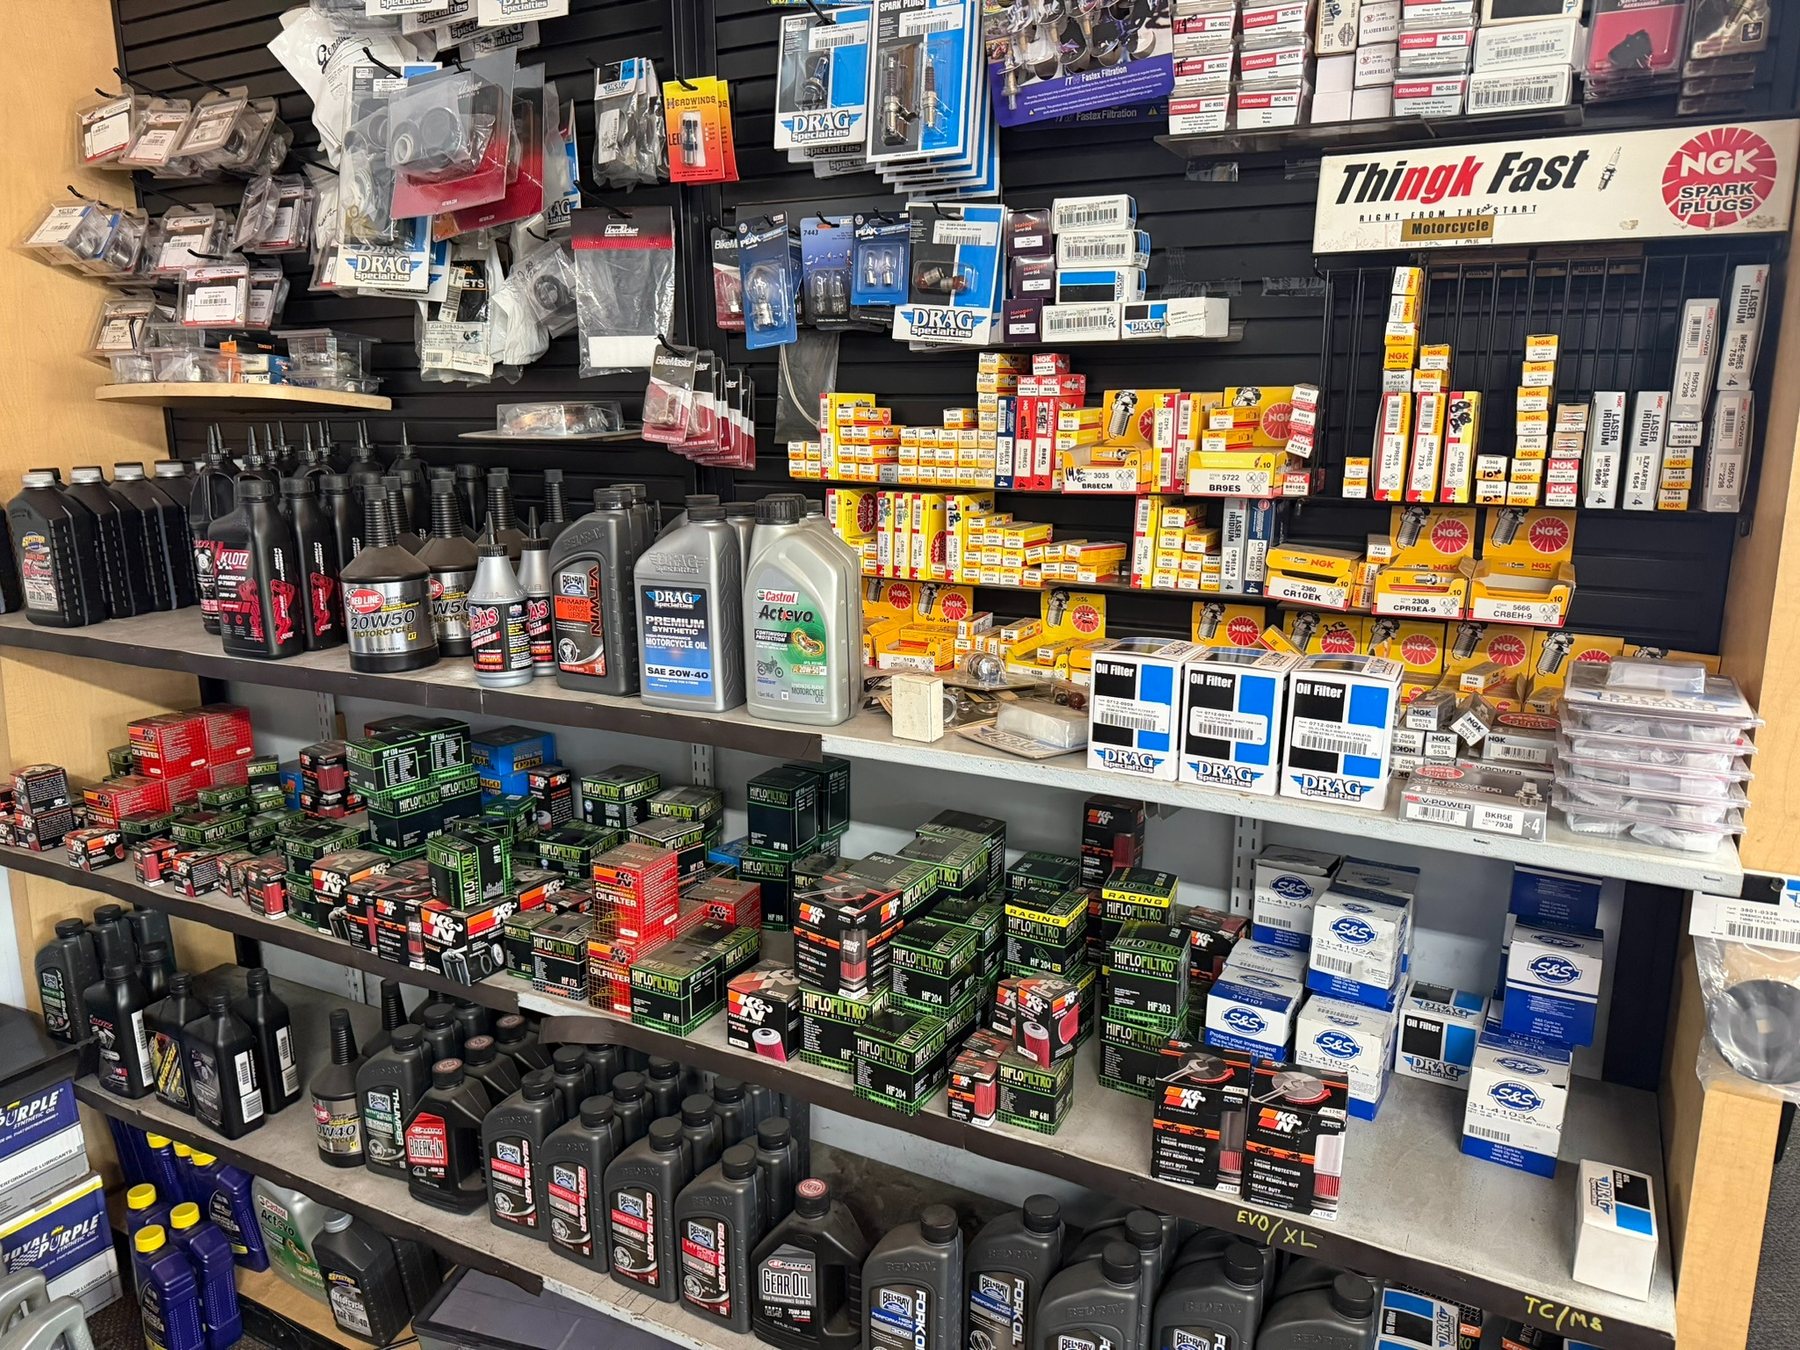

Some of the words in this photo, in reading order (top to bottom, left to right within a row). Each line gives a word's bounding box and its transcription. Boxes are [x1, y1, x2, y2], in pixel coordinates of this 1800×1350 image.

[880, 0, 900, 12] SPARK
[902, 0, 925, 10] PLUGS
[1246, 14, 1275, 24] STANDARD
[1082, 71, 1101, 82] Fastex
[1102, 65, 1127, 79] Filtration
[1102, 108, 1137, 119] Filtration
[1171, 103, 1198, 111] STANDARD
[792, 111, 850, 131] DRAG
[791, 128, 850, 140] Specialties
[1680, 149, 1760, 177] NGK
[1335, 155, 1484, 205] Thingk
[1486, 149, 1590, 195] Fast
[1680, 182, 1756, 199] SPARK
[1493, 203, 1537, 215] START
[1679, 198, 1753, 215] PLUGS
[855, 226, 878, 238] PEAK
[1411, 219, 1489, 235] Motorcycle
[356, 254, 411, 274] DRAG
[1736, 285, 1751, 323] IRIDIUM
[1746, 289, 1760, 319] LASER
[912, 308, 974, 329] DRAG
[1130, 320, 1164, 331] DRAG
[910, 326, 974, 338] Specialties
[655, 354, 695, 368] BikeMaster
[1387, 352, 1409, 360] NGK
[1601, 409, 1612, 445] IRIDIUM
[1610, 414, 1620, 441] LASER
[1639, 410, 1652, 446] IRIDIUM
[1650, 414, 1660, 442] LASER
[1551, 460, 1573, 469] NGK
[1093, 472, 1110, 480] 3035
[1221, 473, 1240, 481] 5722
[1081, 482, 1113, 490] BR8ECM
[1209, 484, 1242, 493] BR9ES
[1551, 485, 1573, 493] NGK
[1228, 512, 1236, 542] IRIDIUM
[1234, 515, 1242, 539] LASER
[1437, 528, 1462, 538] NGK
[1536, 526, 1562, 537] NGK
[221, 552, 249, 566] KLOTZ
[1310, 558, 1336, 569] NGK
[352, 596, 362, 606] RED
[364, 595, 381, 606] LINE
[655, 591, 693, 603] DRAG
[765, 591, 795, 603] Castrol
[1283, 589, 1322, 601] CR10EK
[759, 605, 815, 622] Actevo
[1393, 604, 1436, 613] CPR9EA-9
[1493, 610, 1532, 620] CR8EH-9
[350, 609, 416, 630] 20W50
[645, 616, 704, 629] PREMIUM
[354, 624, 413, 638] MOTORCYCLE
[652, 626, 698, 635] SYNTHETIC
[1231, 624, 1253, 633] NGK
[646, 638, 693, 648] MOTORCYCLE
[1406, 642, 1431, 651] NGK
[1494, 643, 1519, 652] NGK
[648, 667, 666, 675] SAE
[669, 669, 709, 679] 20W-40
[1096, 662, 1109, 674] Oil
[1110, 664, 1134, 678] Filter
[1190, 672, 1204, 685] Oil
[1206, 674, 1233, 688] Filter
[1296, 682, 1312, 694] Oil
[1314, 684, 1343, 698] Filter
[1104, 749, 1154, 768] DRAG
[1103, 762, 1154, 773] Specialties
[1198, 761, 1252, 781] DRAG
[1198, 774, 1252, 787] Specialties
[1302, 774, 1362, 796] DRAG
[1301, 788, 1361, 801] Specialties
[1422, 797, 1471, 810] V-POWER
[1485, 811, 1512, 821] BKR5E
[1495, 821, 1513, 829] 7938
[1278, 881, 1305, 895] S&S
[1108, 892, 1163, 905] RACING
[1009, 908, 1061, 924] RACING
[1106, 901, 1162, 921] HIFLOFILTRO
[428, 913, 463, 941] K&N
[1008, 917, 1060, 938] HIFLOFILTRO
[1338, 923, 1368, 939] S&S
[1317, 937, 1375, 956] 31-4102A
[893, 947, 945, 970] HIFLOFILTRO
[1114, 951, 1178, 972] HIFLOFILTRO
[1535, 962, 1570, 979] S&S
[632, 970, 678, 992] HIFLOFILTRO
[738, 993, 773, 1020] K&N
[802, 992, 867, 1020] HIFLOFILTRO
[1229, 1013, 1259, 1027] S&S
[1406, 1019, 1417, 1028] Oil
[1419, 1021, 1441, 1033] Filter
[1209, 1031, 1229, 1041] Protect
[1231, 1036, 1243, 1044] your
[1244, 1038, 1277, 1053] investment!
[1321, 1037, 1353, 1053] S&S
[857, 1038, 908, 1064] HIFLOFILTRO
[1300, 1050, 1359, 1071] 31-4102A
[1410, 1056, 1460, 1076] DRAG
[1000, 1064, 1052, 1087] HIFLOFILTRO
[1180, 1089, 1206, 1109] K&N
[1497, 1088, 1533, 1107] S&S
[392, 1089, 404, 1146] THUMPER
[1468, 1102, 1537, 1123] 31-4103A
[1274, 1110, 1302, 1133] K&N
[409, 1137, 444, 1159] BREAK-IN
[1252, 1182, 1270, 1191] HEAVY
[261, 1209, 294, 1237] Actevo
[38, 1216, 99, 1259] PURPLE
[762, 1270, 791, 1297] GEAR
[792, 1274, 812, 1298] OIL
